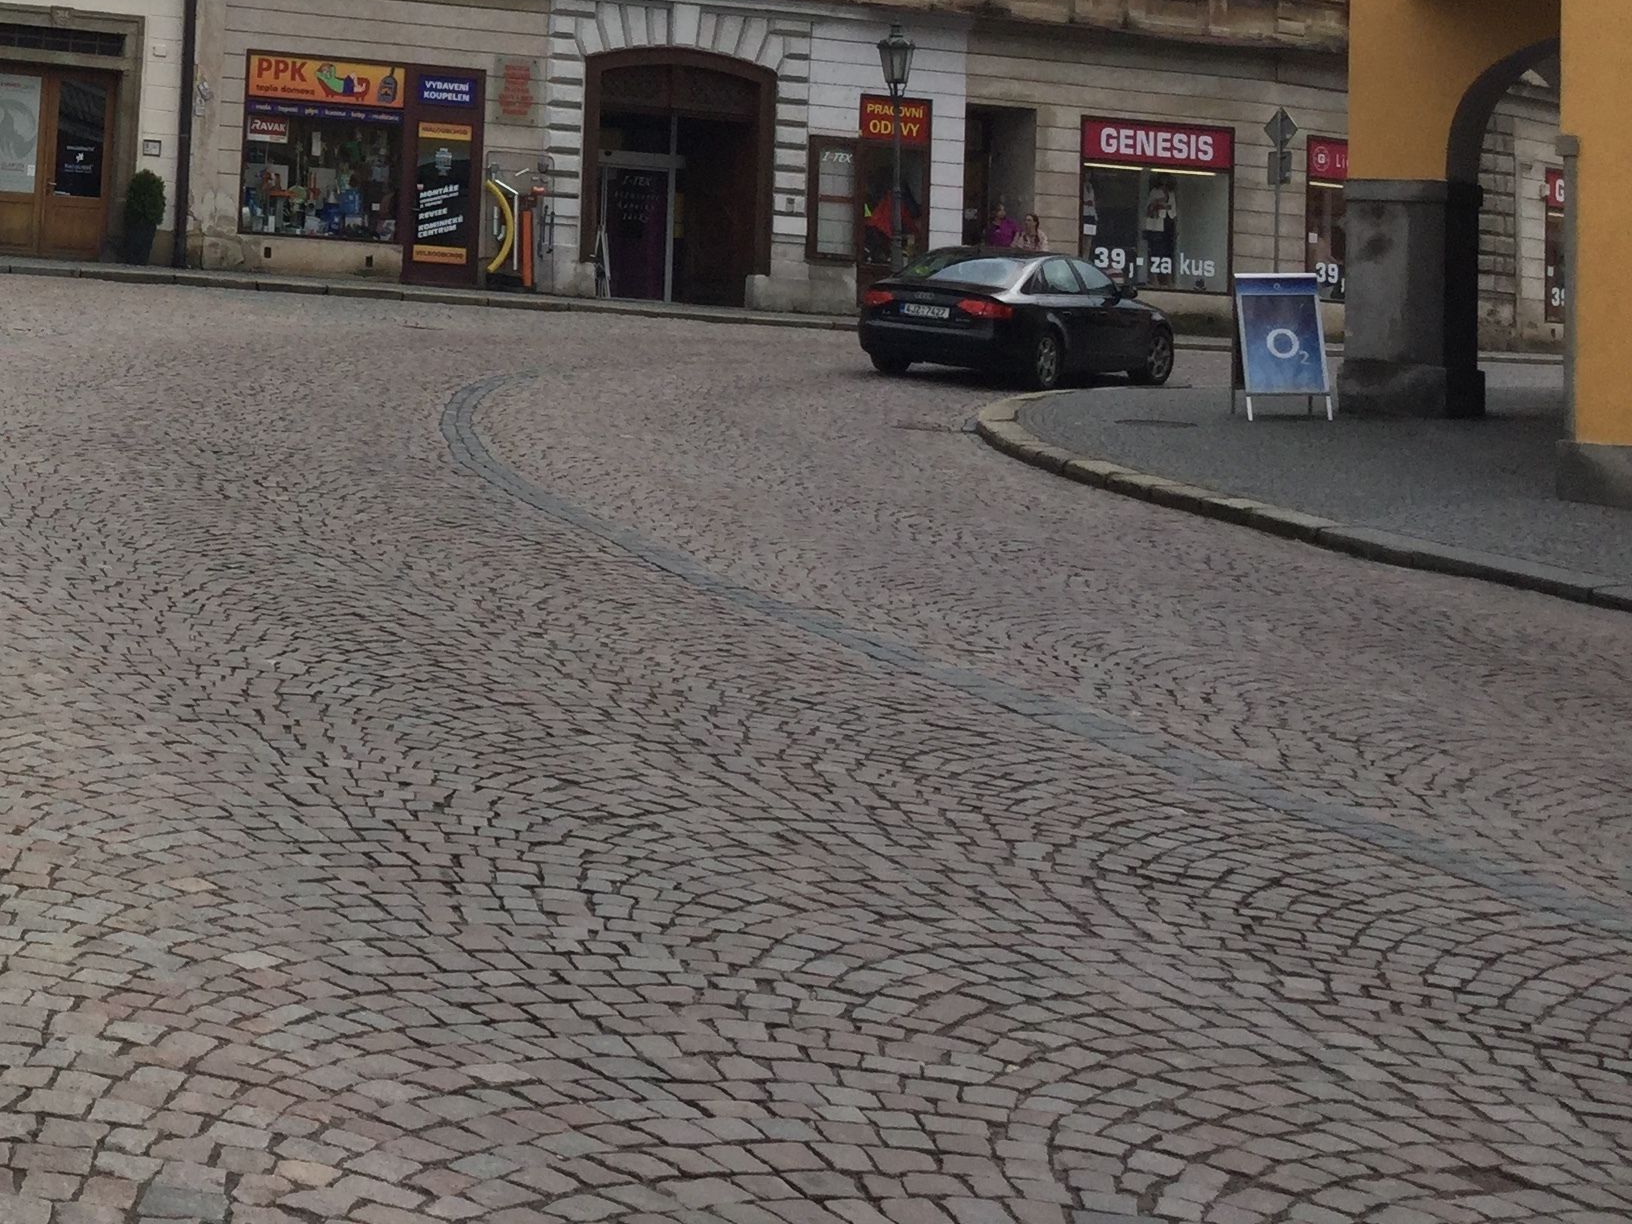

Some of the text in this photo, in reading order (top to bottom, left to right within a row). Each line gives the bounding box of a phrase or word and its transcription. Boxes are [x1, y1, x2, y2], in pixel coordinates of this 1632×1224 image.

[256, 58, 308, 82] PPK
[425, 80, 469, 92] VYBAVENÍ
[423, 91, 470, 102] KOUPELEN
[252, 119, 286, 132] RAVAK
[869, 119, 920, 137] ODVY
[1100, 127, 1214, 161] GENESIS
[822, 151, 853, 163] I-TEX
[418, 207, 448, 221] REVIZE
[417, 225, 457, 238] CENTRUM
[1150, 256, 1172, 274] za
[1179, 252, 1216, 277] kus
